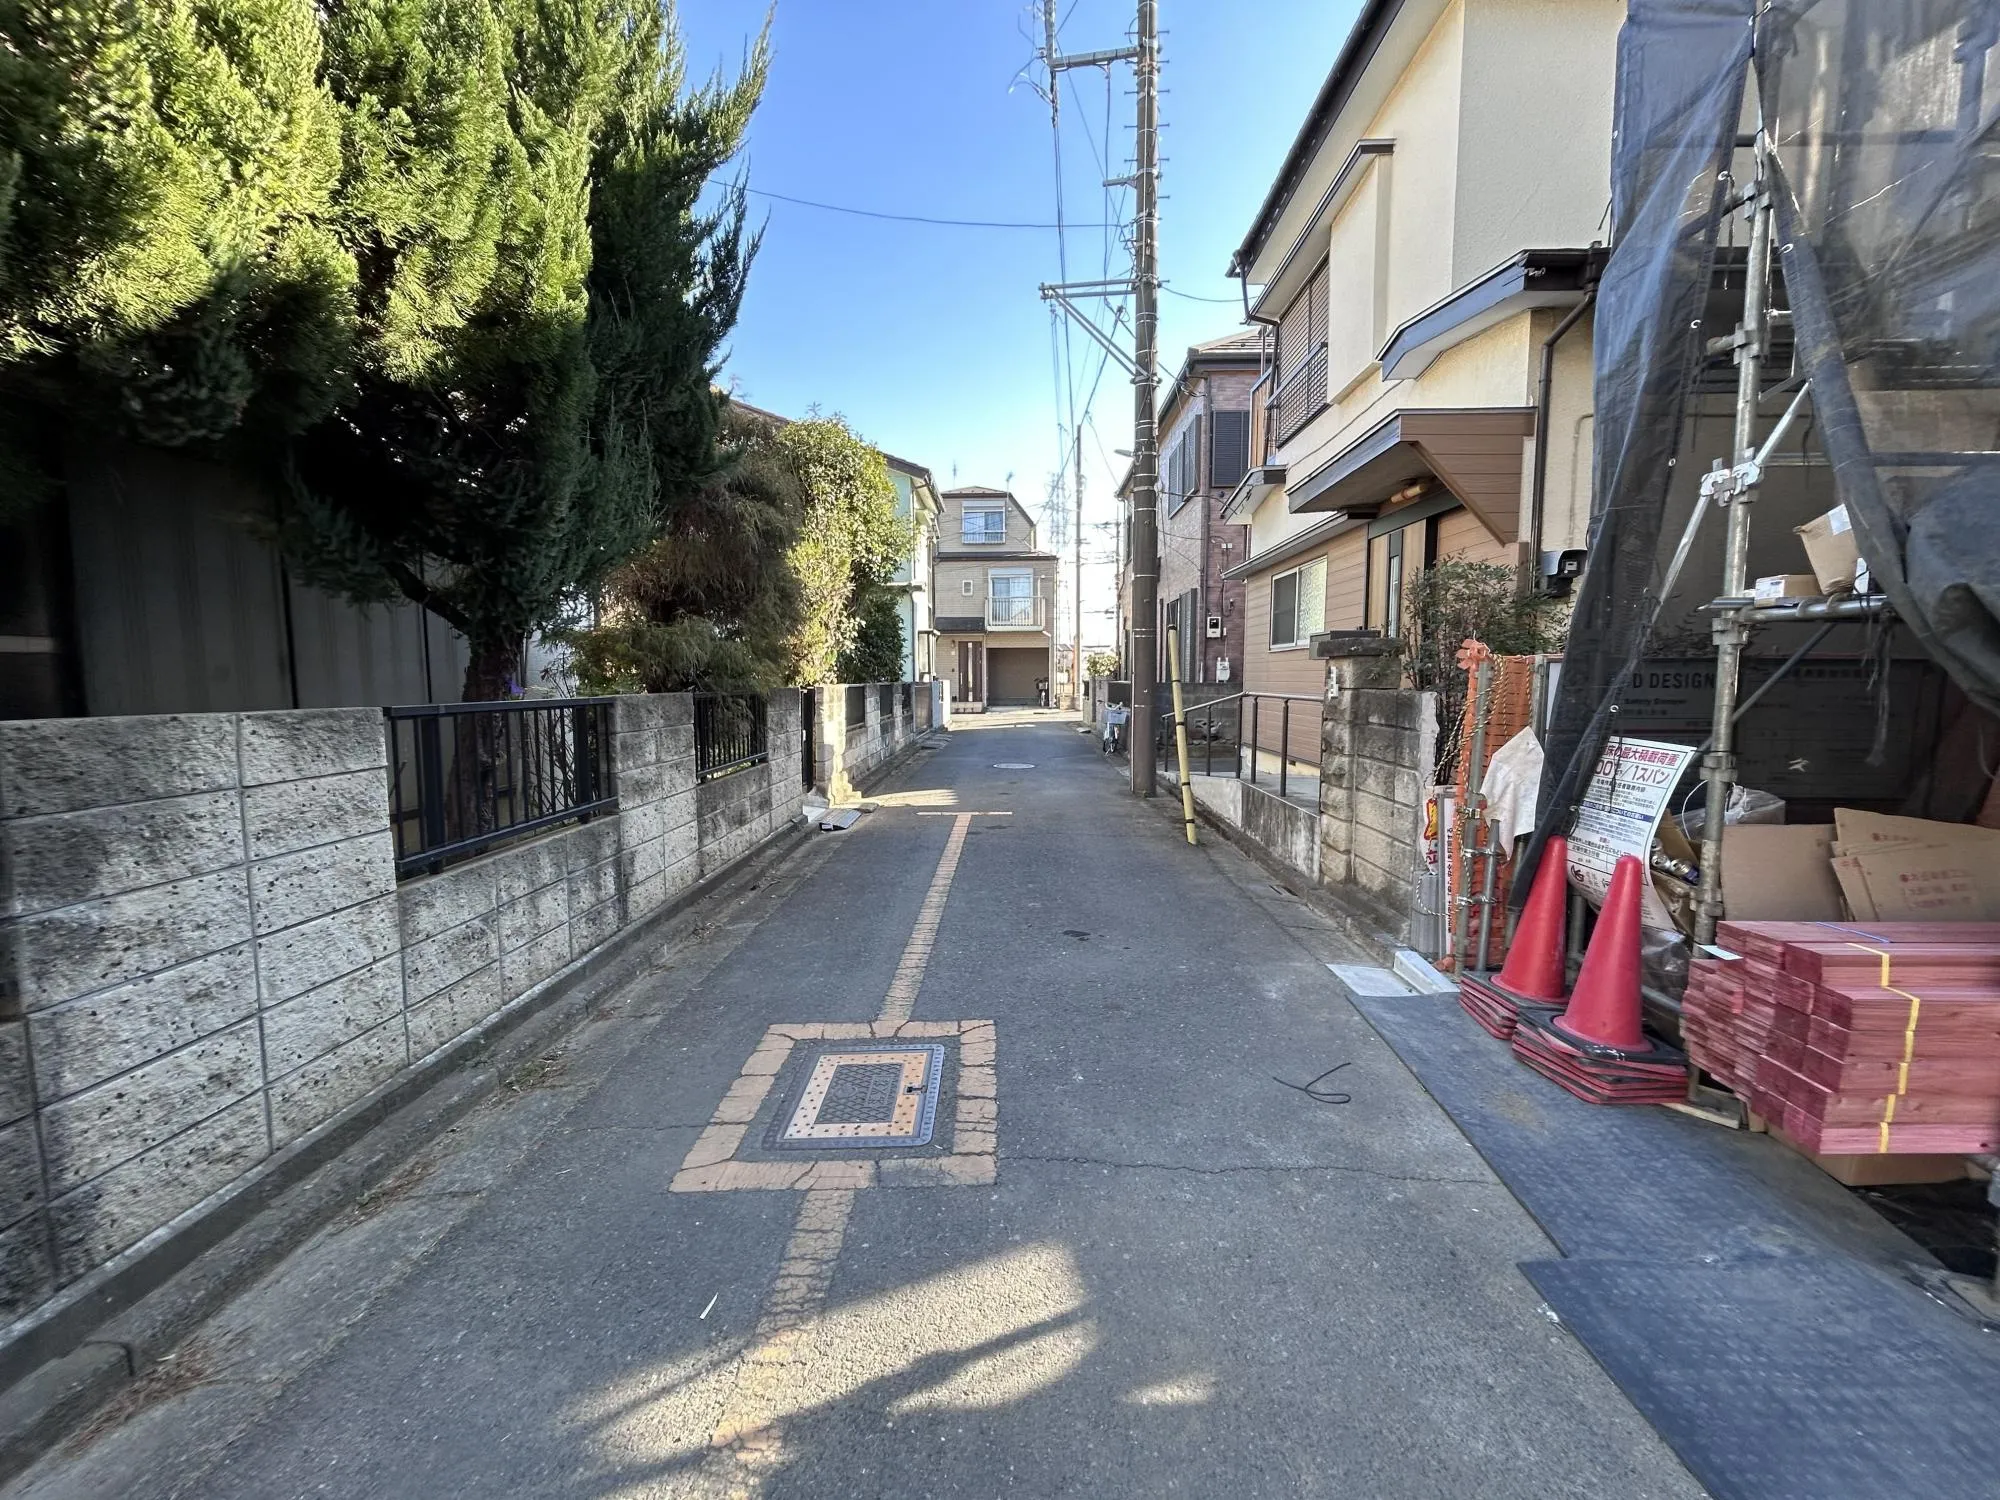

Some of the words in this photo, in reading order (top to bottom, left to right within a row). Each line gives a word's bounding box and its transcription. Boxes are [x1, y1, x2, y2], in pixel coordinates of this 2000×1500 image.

[1649, 672, 1715, 689] DESIGN
[1602, 744, 1681, 767] 床の最大積載荷重
